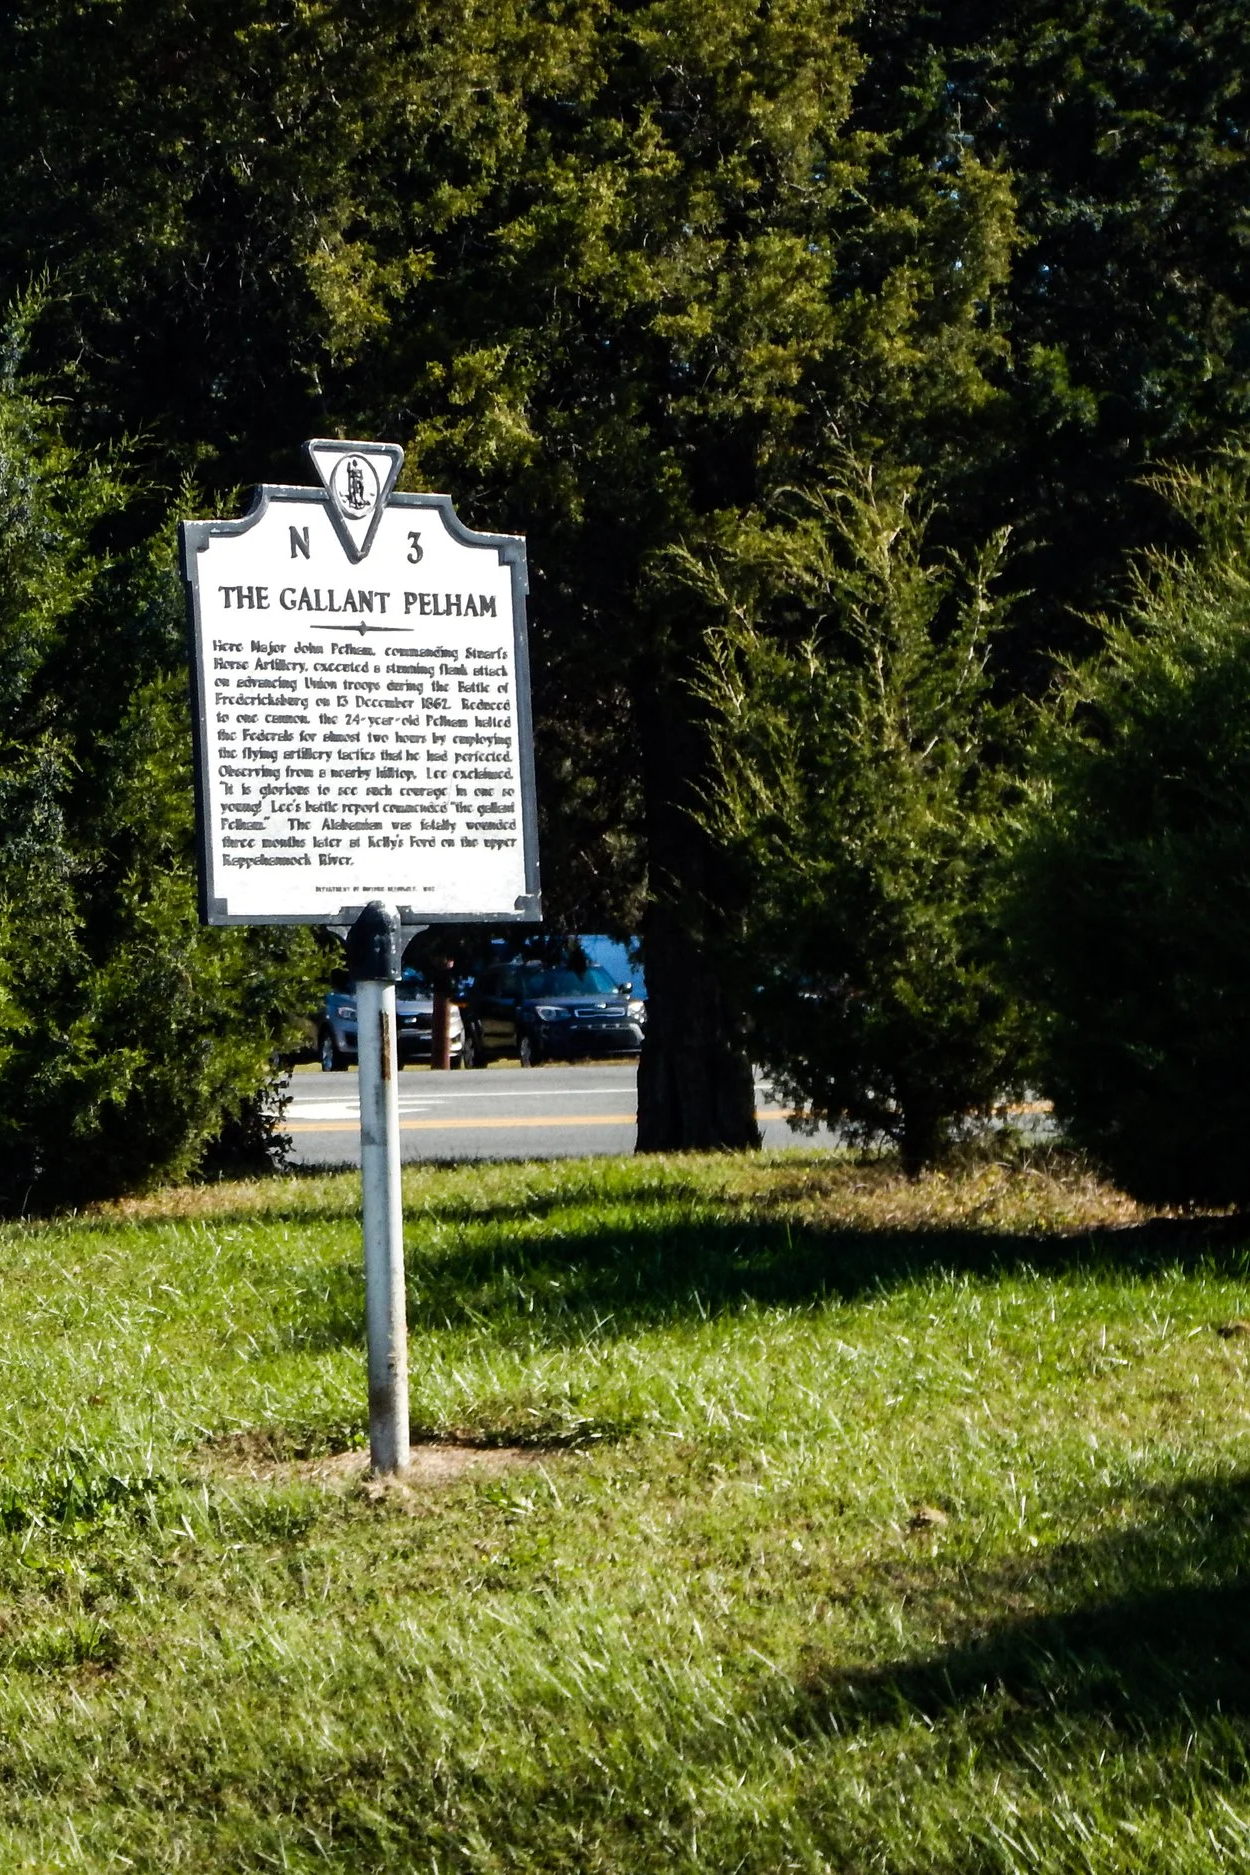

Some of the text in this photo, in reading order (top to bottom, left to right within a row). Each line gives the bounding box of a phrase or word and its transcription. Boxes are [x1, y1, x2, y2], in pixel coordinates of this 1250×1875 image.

[289, 526, 424, 564] N 3
[218, 585, 498, 618] THE GALLANT PELHAM
